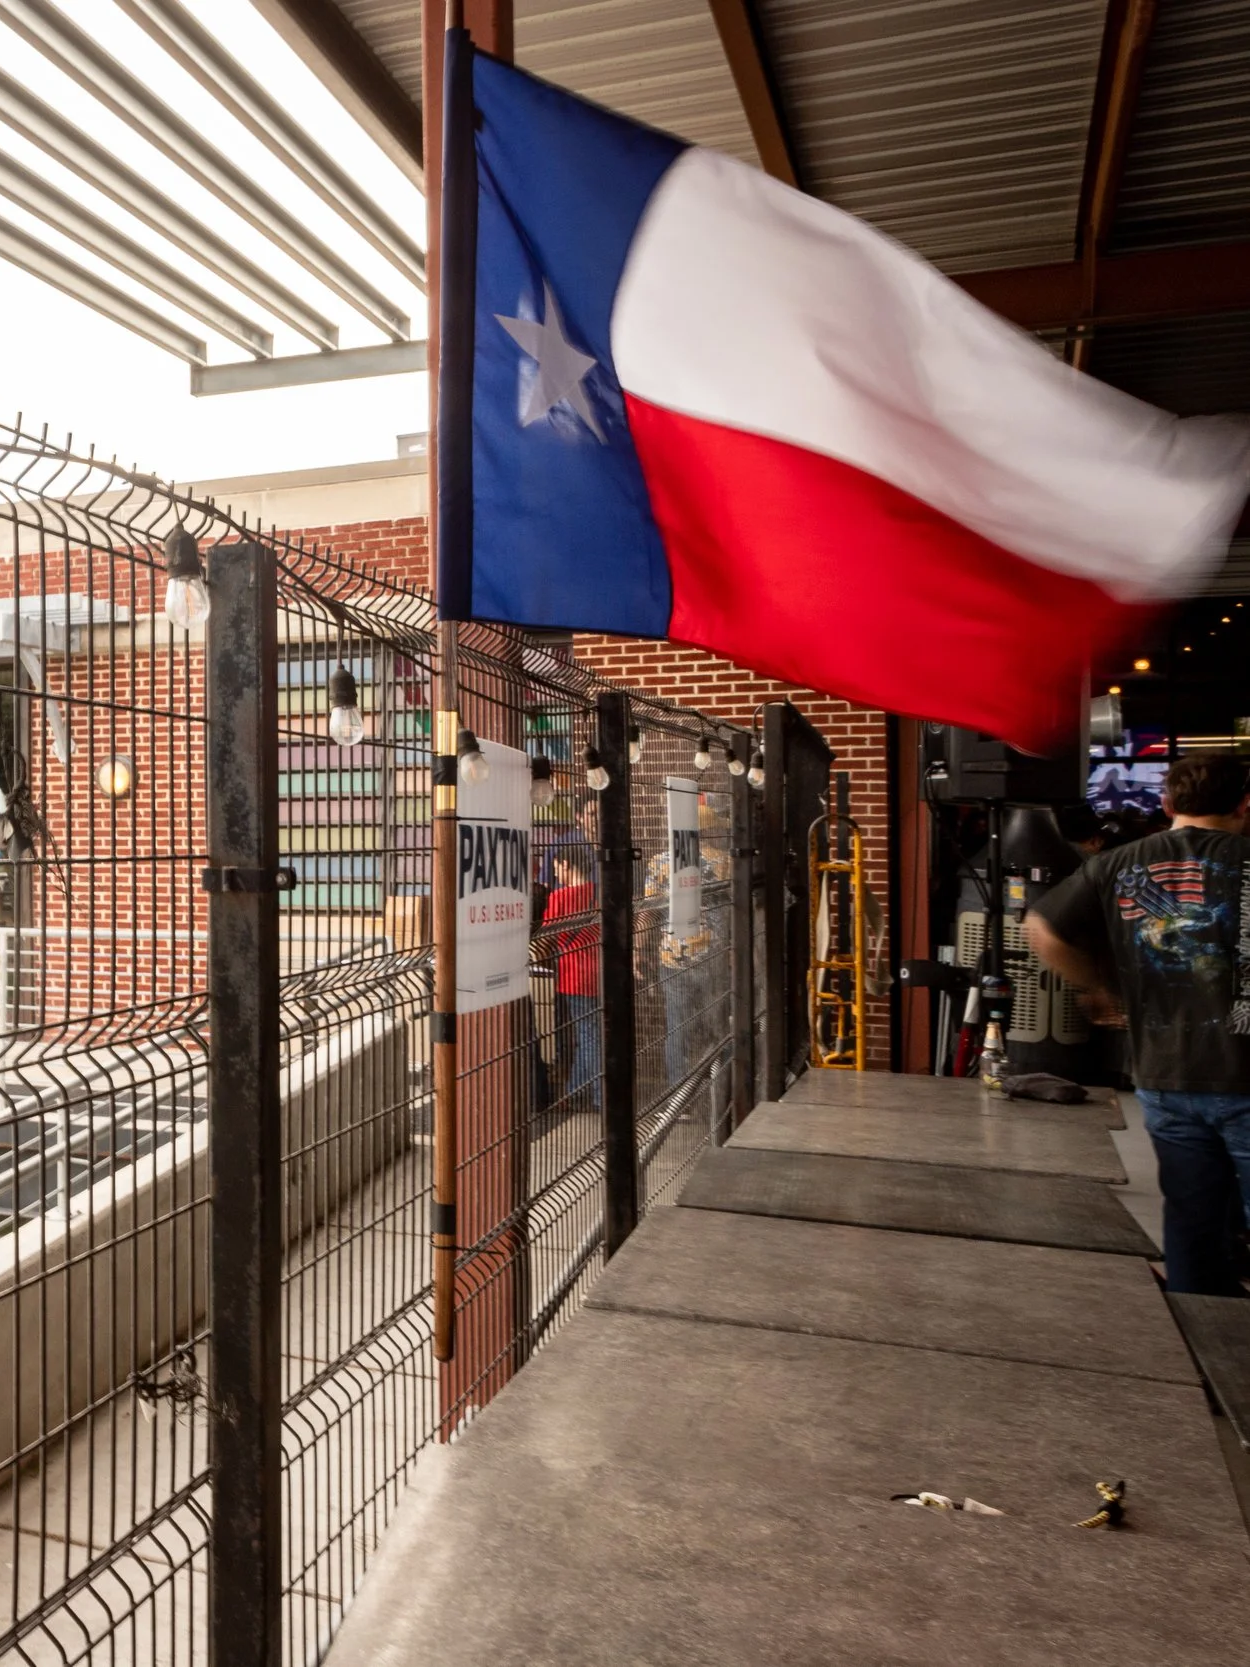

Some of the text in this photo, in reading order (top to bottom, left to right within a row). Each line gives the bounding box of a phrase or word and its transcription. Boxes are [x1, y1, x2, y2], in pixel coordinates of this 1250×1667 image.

[459, 824, 528, 899] PAXTON
[469, 902, 524, 924] U.S. SENATE
